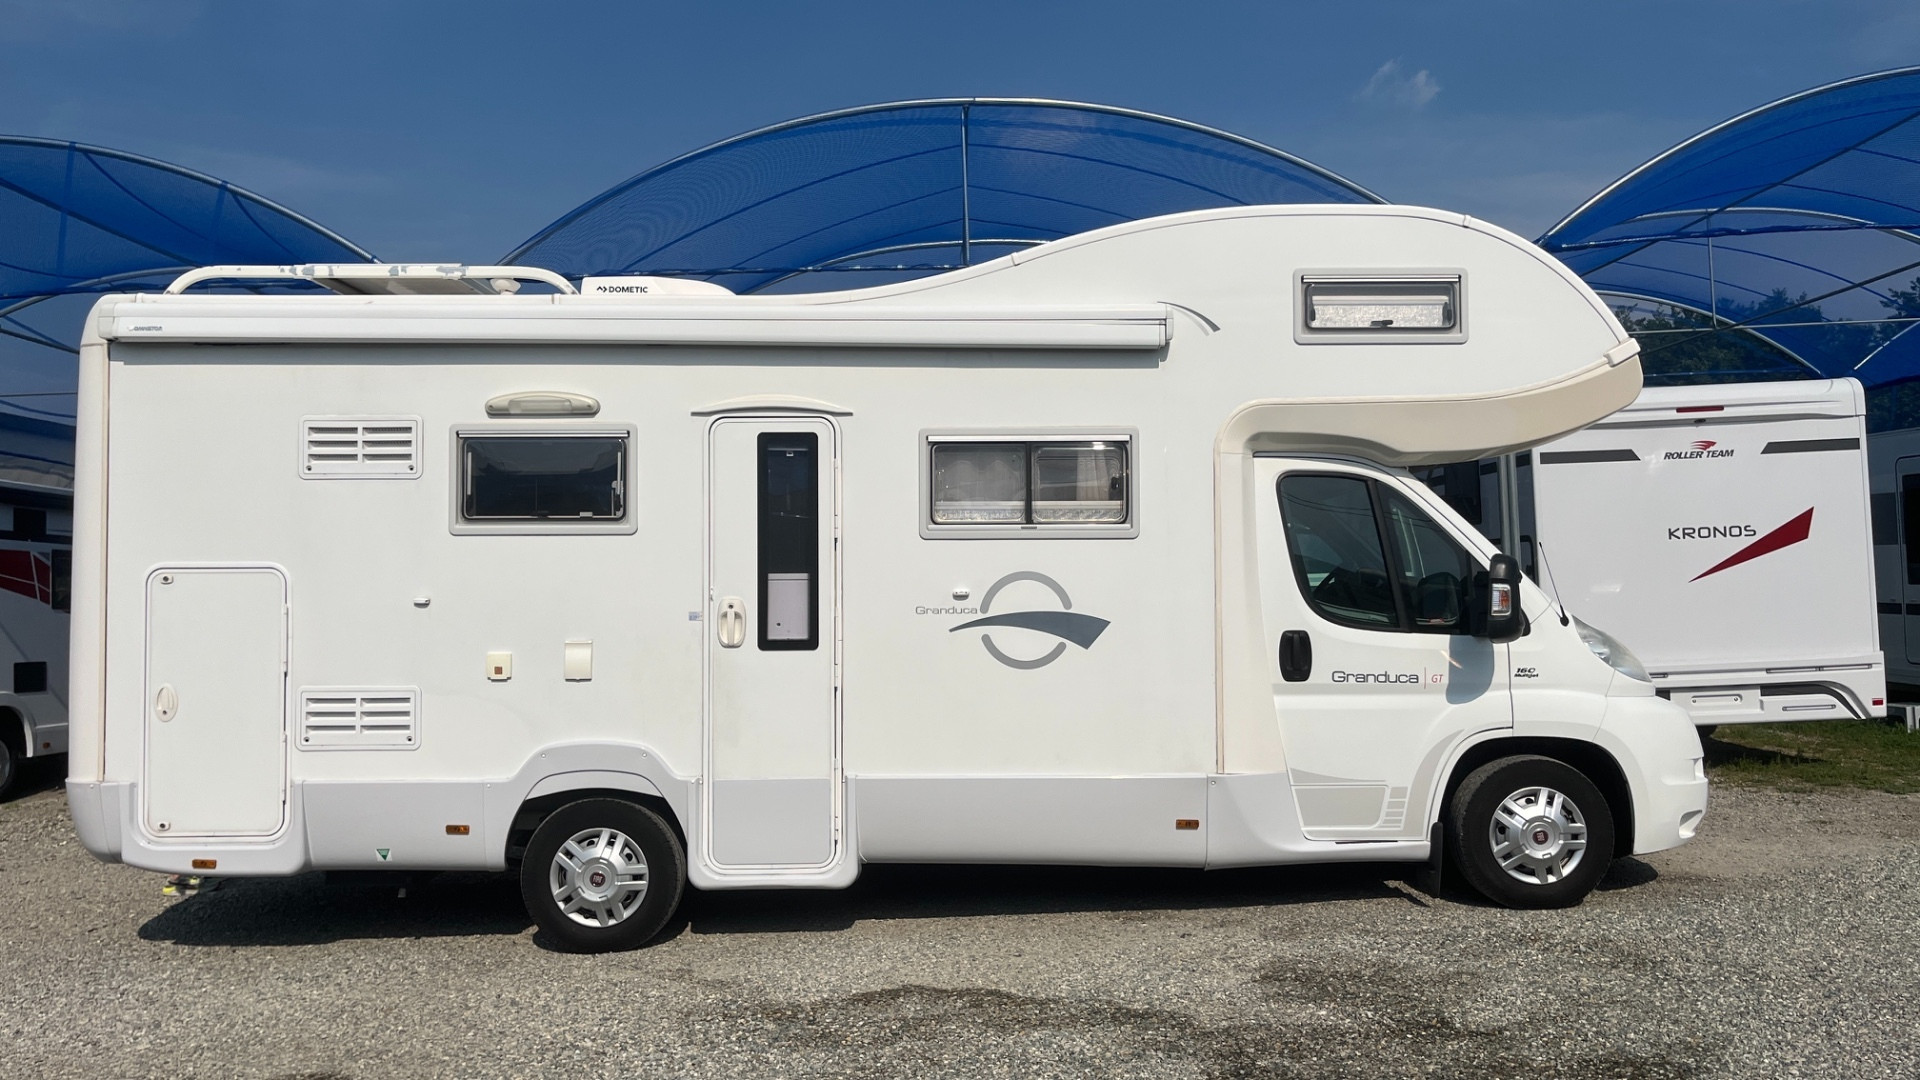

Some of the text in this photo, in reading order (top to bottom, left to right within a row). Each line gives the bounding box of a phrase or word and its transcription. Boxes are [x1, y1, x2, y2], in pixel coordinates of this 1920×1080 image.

[608, 285, 648, 294] DOMETIC
[1663, 449, 1735, 460] ROLLER TEAM
[1668, 524, 1757, 540] KRONOS
[915, 605, 978, 615] Granduca
[1331, 670, 1444, 684] Granduca GT
